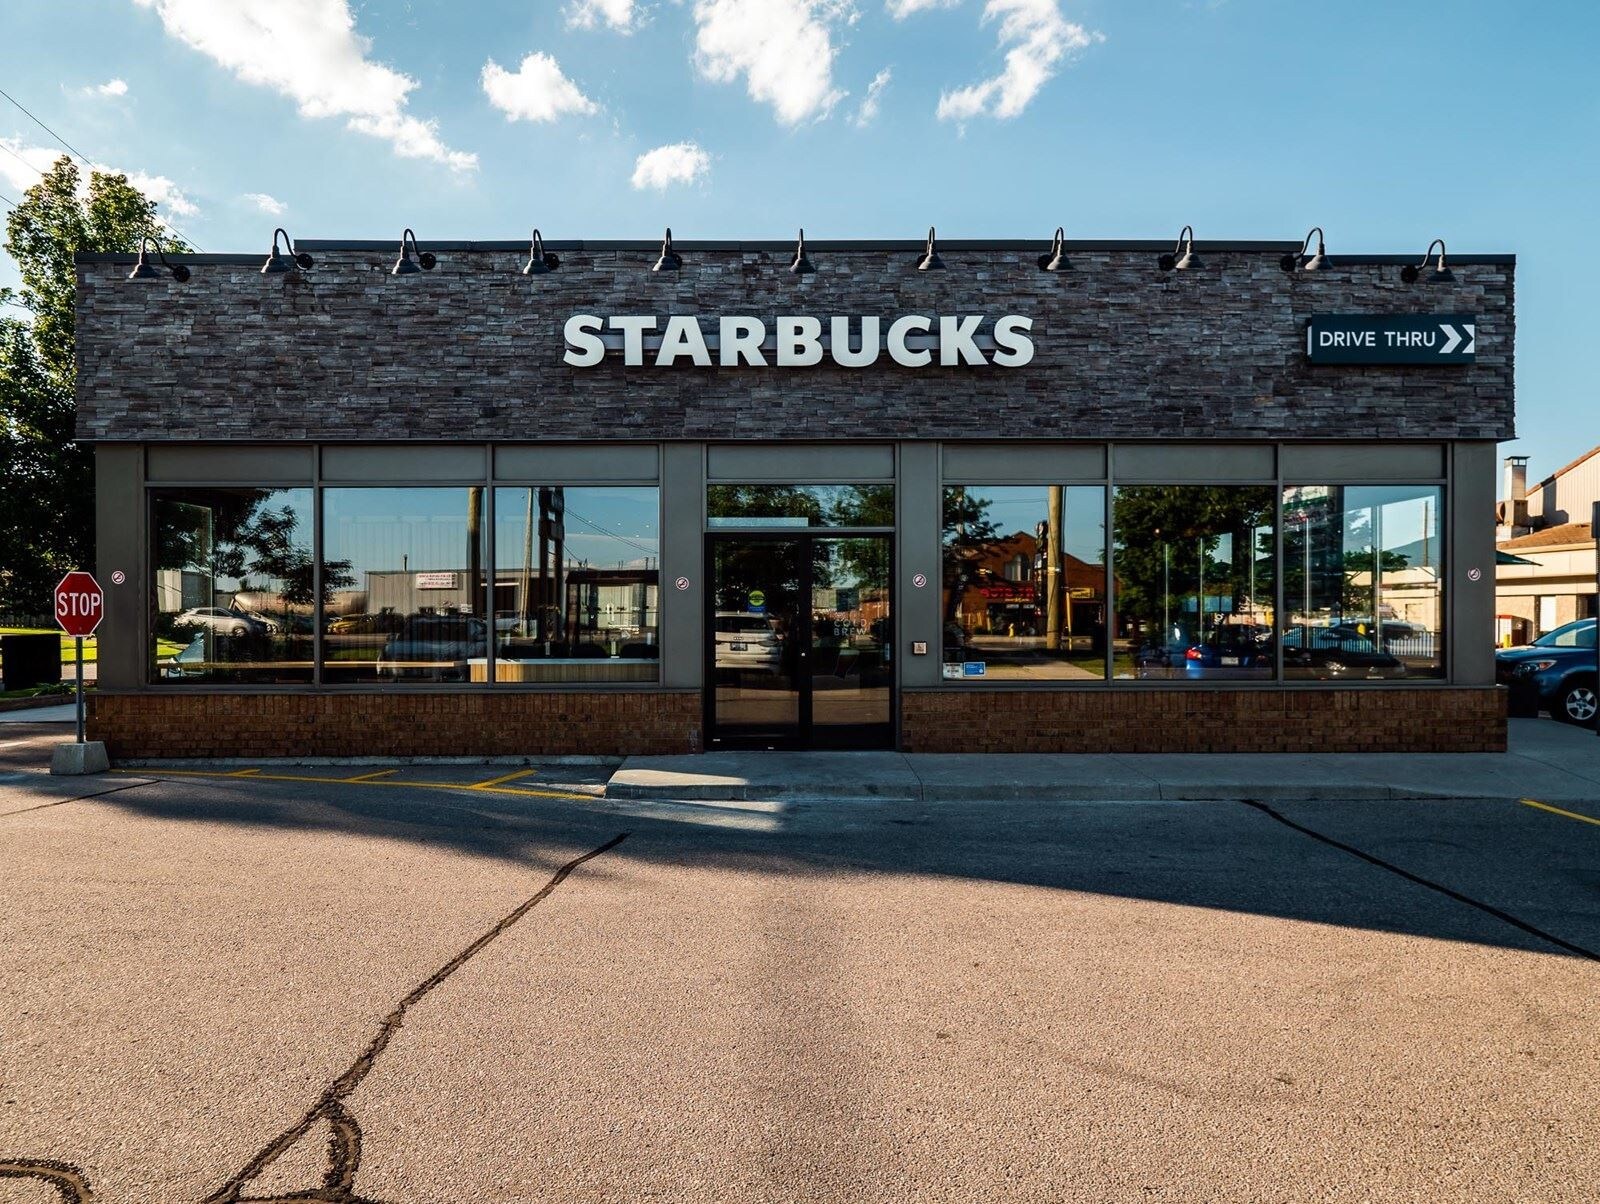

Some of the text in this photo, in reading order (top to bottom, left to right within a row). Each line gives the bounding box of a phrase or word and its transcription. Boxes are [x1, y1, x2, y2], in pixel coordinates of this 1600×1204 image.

[563, 315, 1035, 368] STARBUCKS
[1319, 331, 1436, 347] DRIVE THRU
[57, 592, 101, 617] STOP
[834, 619, 867, 627] COLD
[834, 628, 867, 636] BREW
